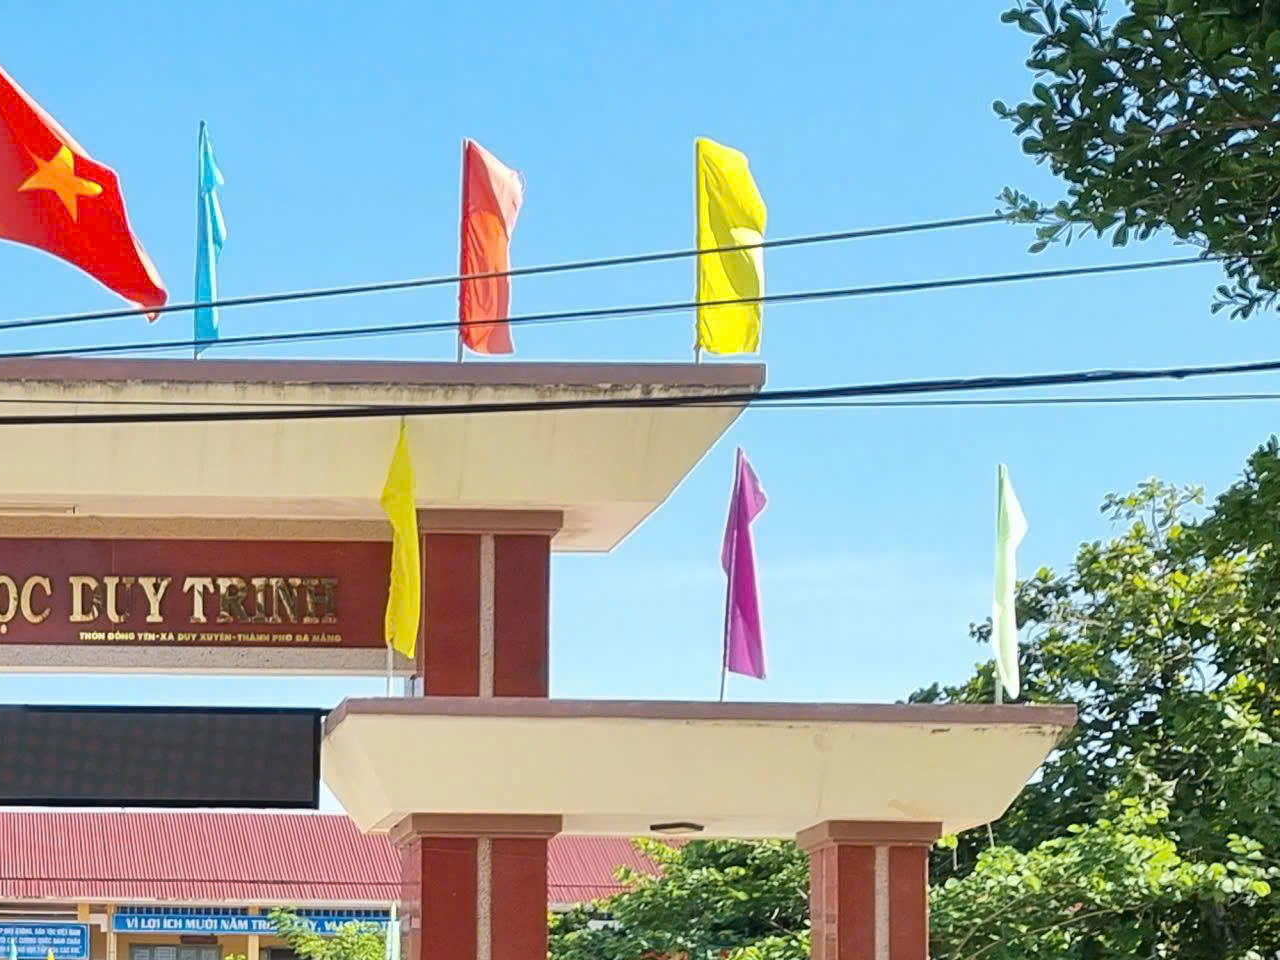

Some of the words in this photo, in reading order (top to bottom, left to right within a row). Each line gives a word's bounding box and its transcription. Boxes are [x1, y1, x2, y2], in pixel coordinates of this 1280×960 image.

[69, 575, 172, 624] DUY
[182, 576, 338, 624] TRINH
[177, 632, 197, 641] DUY
[126, 916, 139, 929] VÌ
[162, 917, 182, 929] ÍCH
[220, 917, 249, 930] NĂM
